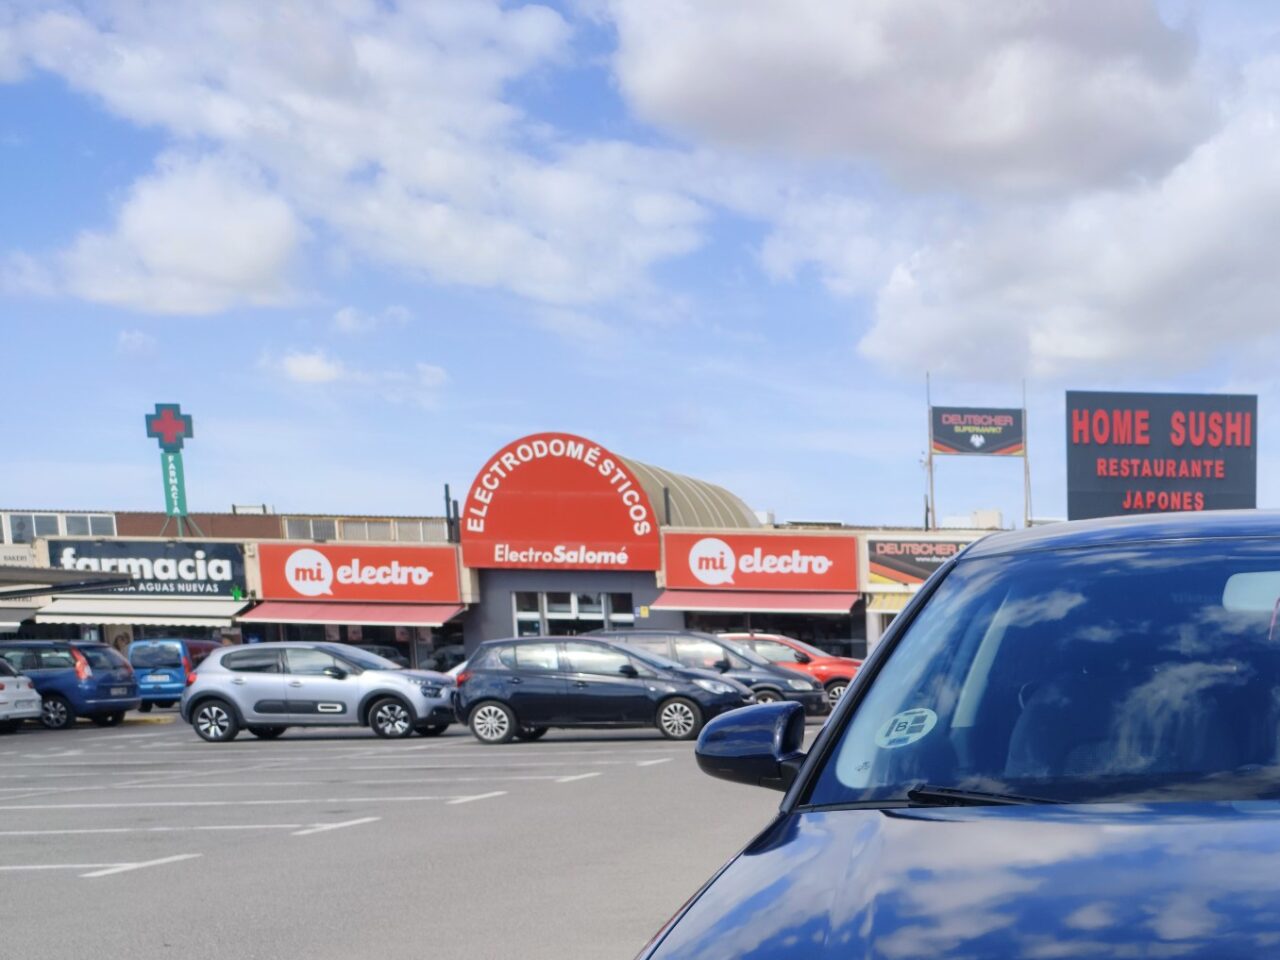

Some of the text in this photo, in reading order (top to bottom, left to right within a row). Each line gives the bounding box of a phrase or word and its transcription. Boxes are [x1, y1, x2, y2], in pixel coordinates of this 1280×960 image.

[942, 414, 1013, 425] DEUTSCHER
[1072, 409, 1252, 447] HOME SUSHI
[1097, 458, 1225, 479] RESTAURANTE
[168, 455, 181, 514] FARMACIA
[467, 439, 651, 536] ELECTRODOMÉSTICOS
[1122, 491, 1204, 511] JAPONES
[494, 543, 629, 565] ElectroSalomé
[698, 547, 834, 574] mi electro
[876, 543, 957, 555] DEUTSCHER
[60, 547, 233, 581] farmacia
[295, 558, 434, 585] mi electro
[138, 583, 175, 592] AGUAS
[178, 583, 219, 593] NUEVAS
